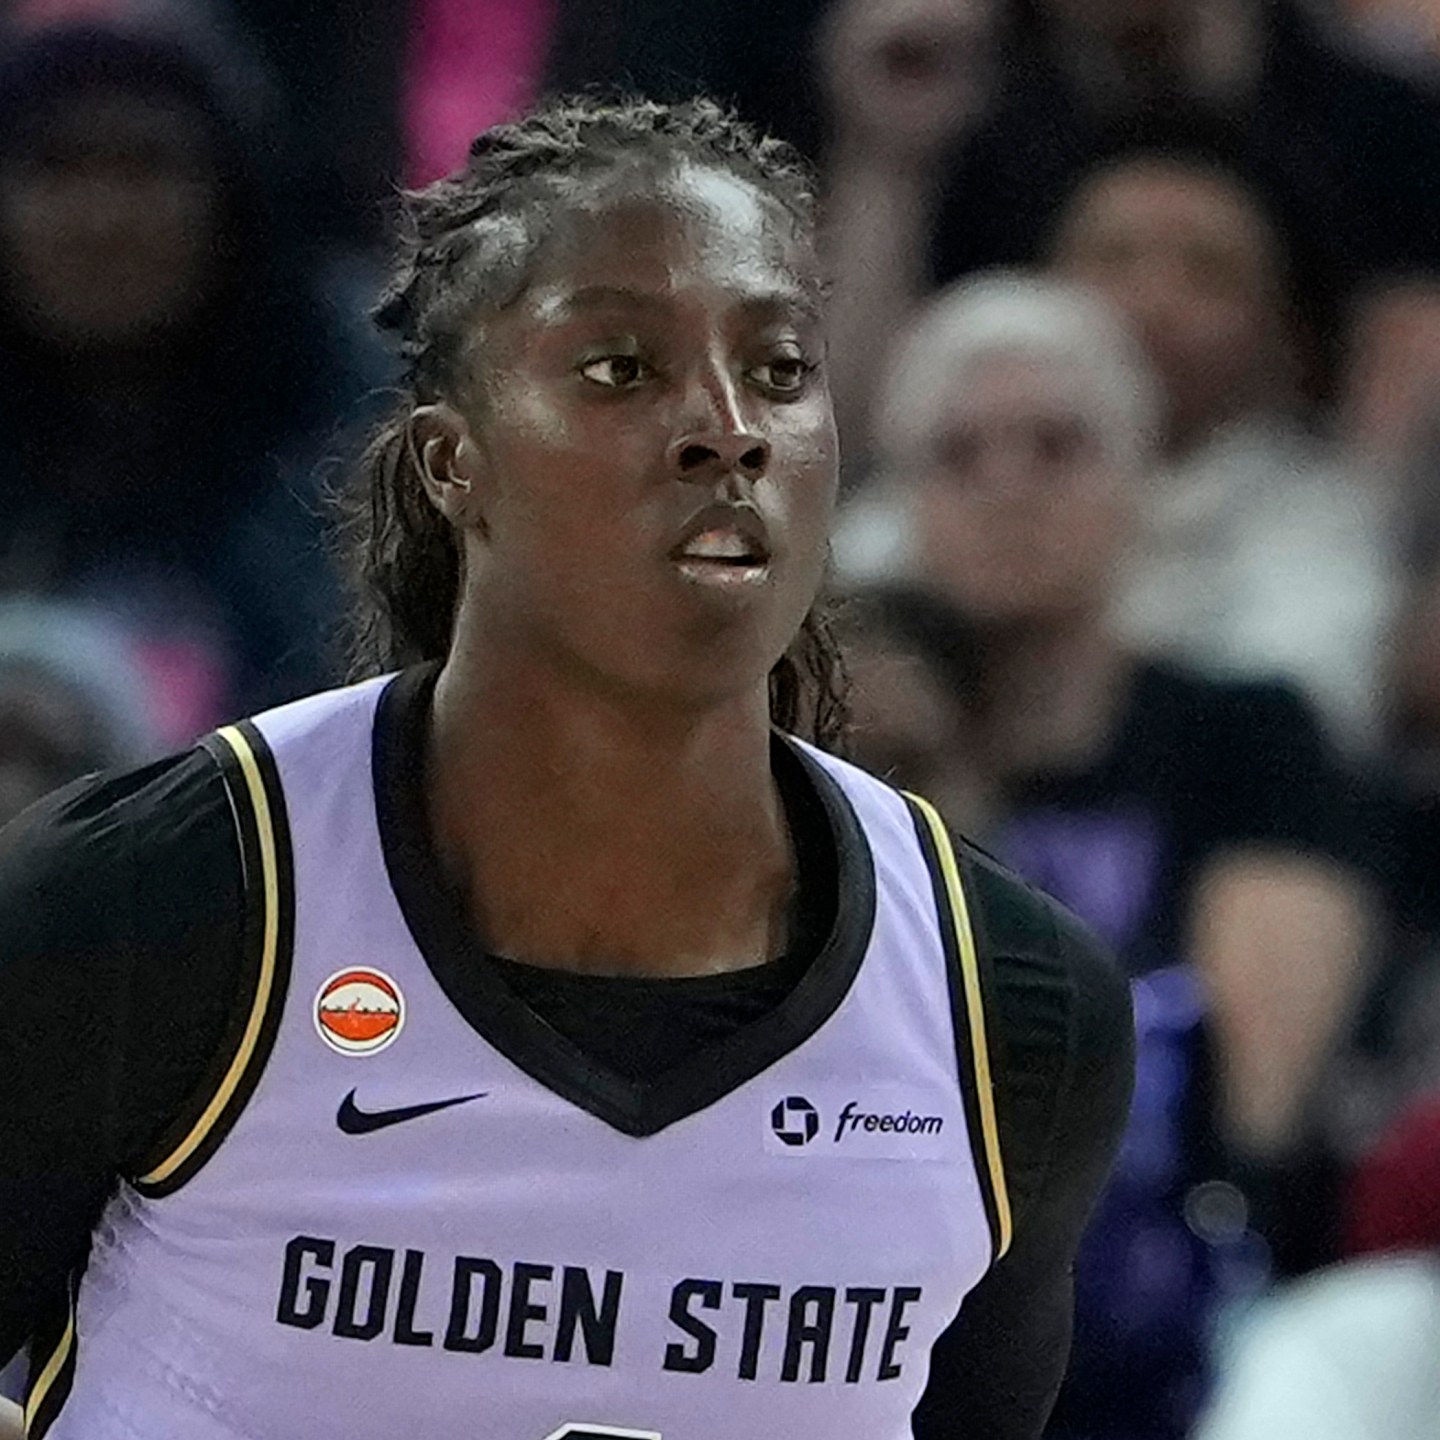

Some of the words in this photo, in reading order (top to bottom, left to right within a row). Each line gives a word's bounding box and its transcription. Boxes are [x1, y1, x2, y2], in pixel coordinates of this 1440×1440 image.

[833, 1101, 945, 1143] freedom
[275, 1235, 625, 1368] GOLDEN
[662, 1277, 923, 1384] STATE
